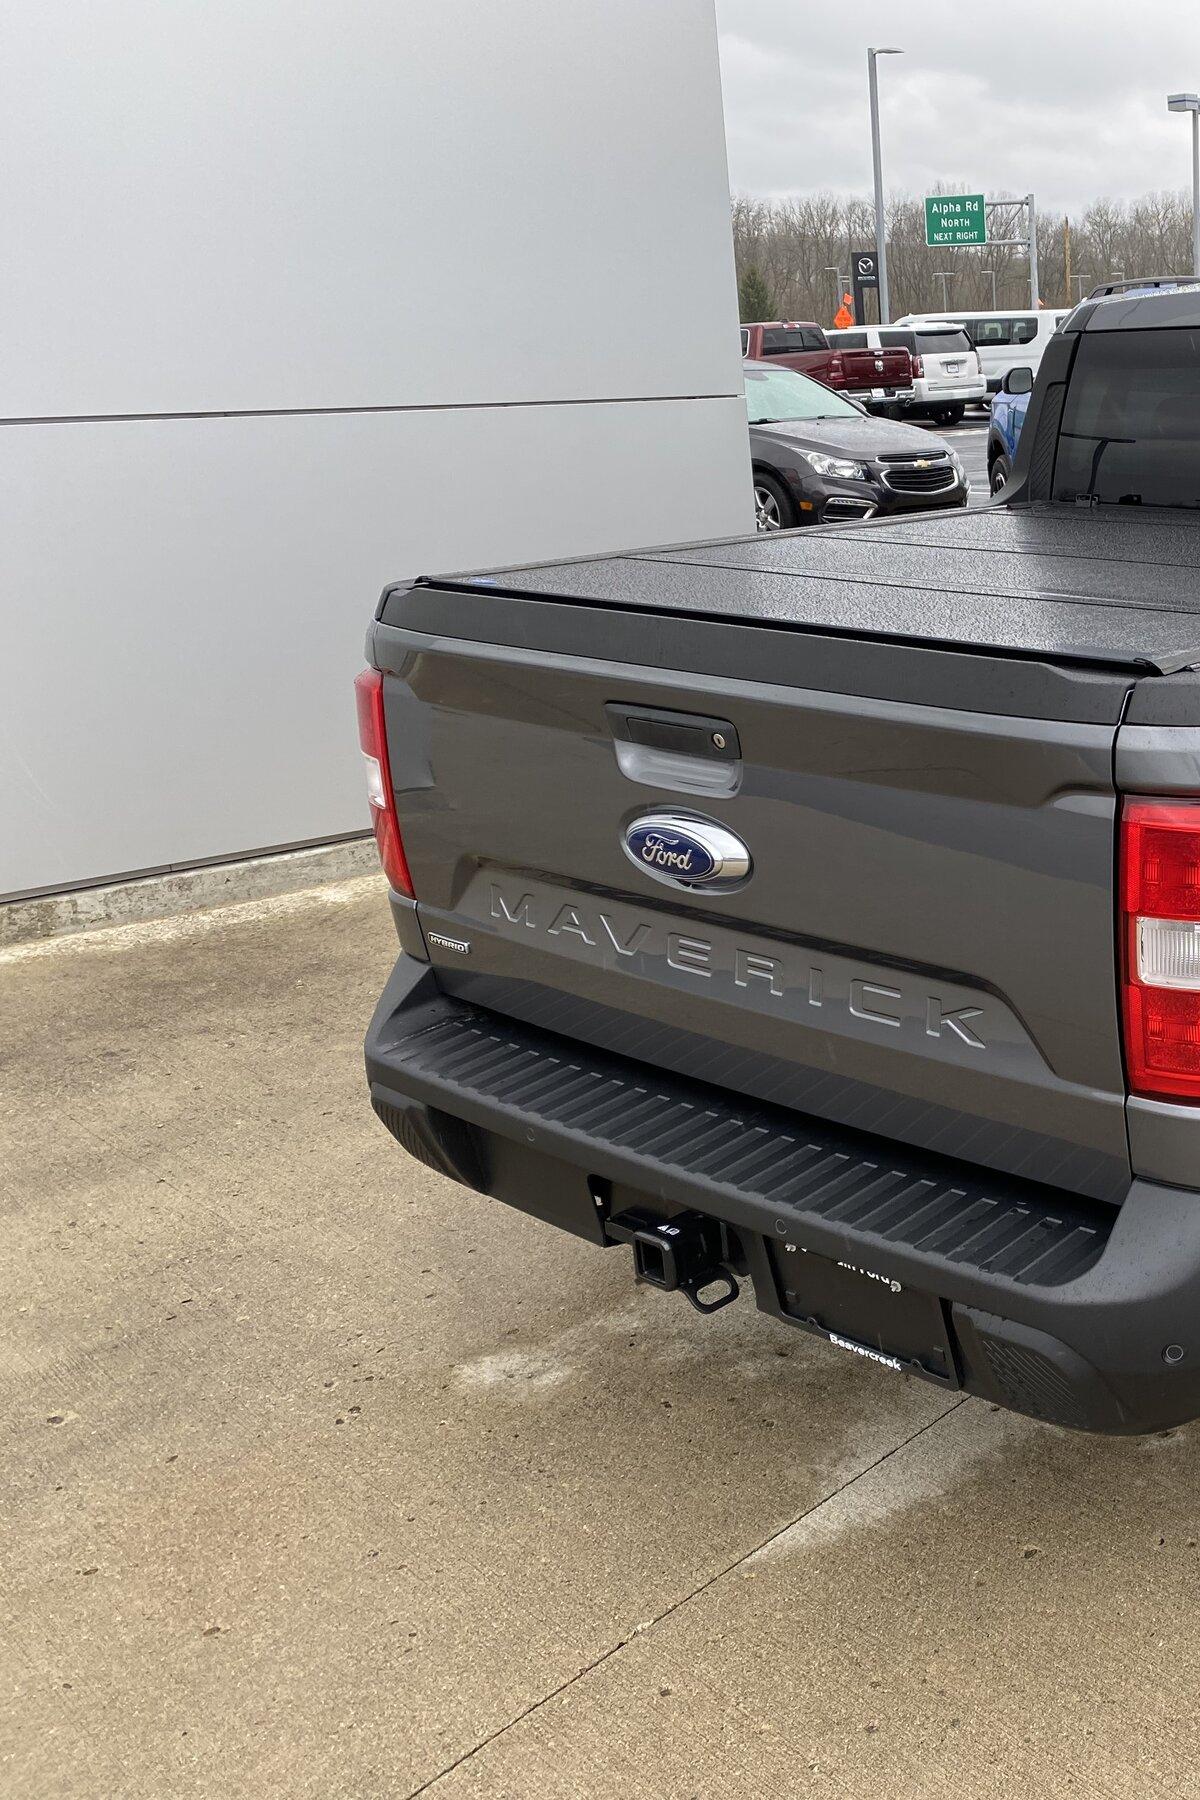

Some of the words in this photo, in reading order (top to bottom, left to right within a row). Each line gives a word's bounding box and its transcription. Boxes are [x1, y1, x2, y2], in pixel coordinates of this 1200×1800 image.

[931, 202, 961, 215] Alpha
[965, 201, 979, 212] Rd
[941, 218, 970, 228] NORTH
[933, 232, 953, 241] NEXT
[956, 231, 979, 240] RIGHT
[641, 832, 693, 871] Ford
[430, 935, 465, 952] HYBRID
[490, 883, 986, 1049] MAVERICK
[829, 1332, 902, 1371] Beavercreek
